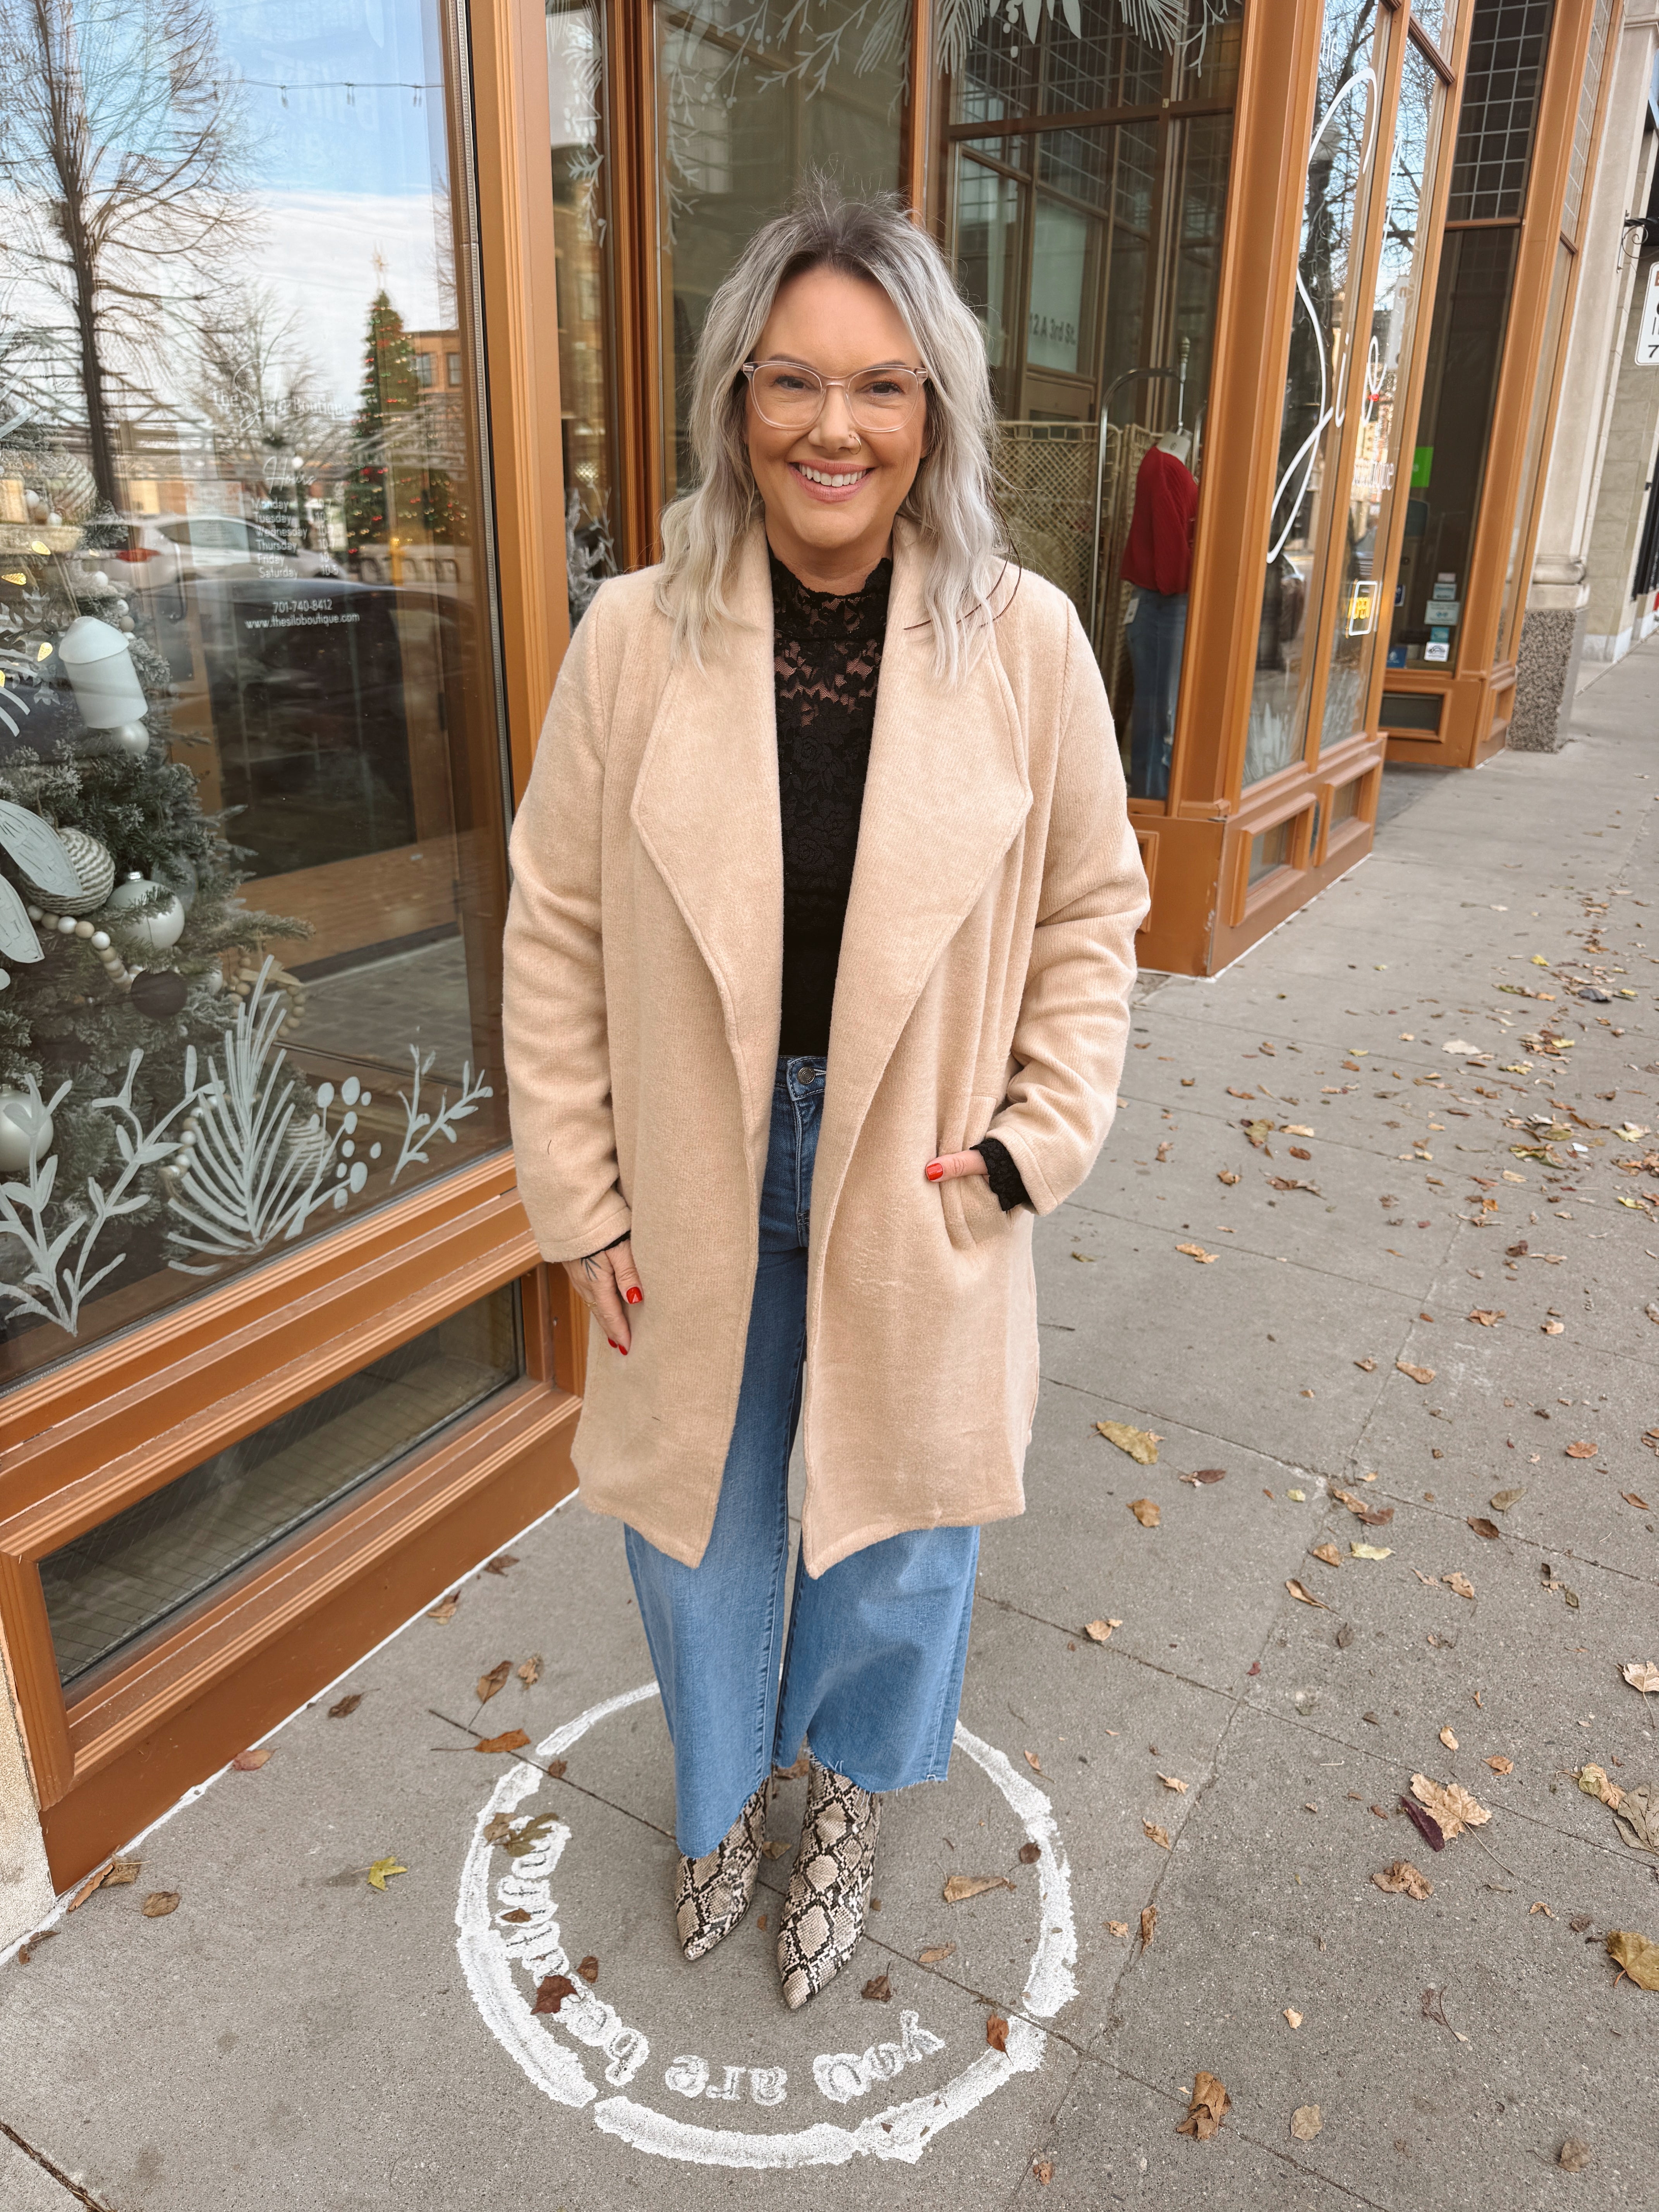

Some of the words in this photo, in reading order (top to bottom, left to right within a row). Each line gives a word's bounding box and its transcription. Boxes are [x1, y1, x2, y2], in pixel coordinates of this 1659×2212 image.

[1321, 11, 1342, 73] he
[263, 456, 316, 494] Hours
[252, 496, 289, 513] Monday
[252, 511, 291, 526] Tuesday
[254, 524, 307, 539] Wednesday
[256, 539, 297, 553] Thursday
[257, 552, 285, 567] Friday
[258, 565, 298, 580] Saturday
[272, 598, 333, 614] 701-740-8412
[244, 612, 360, 629] www.thesiloboutique.com
[494, 1815, 649, 2086] beutifu
[813, 2009, 945, 2104] you
[665, 2055, 788, 2106] are
